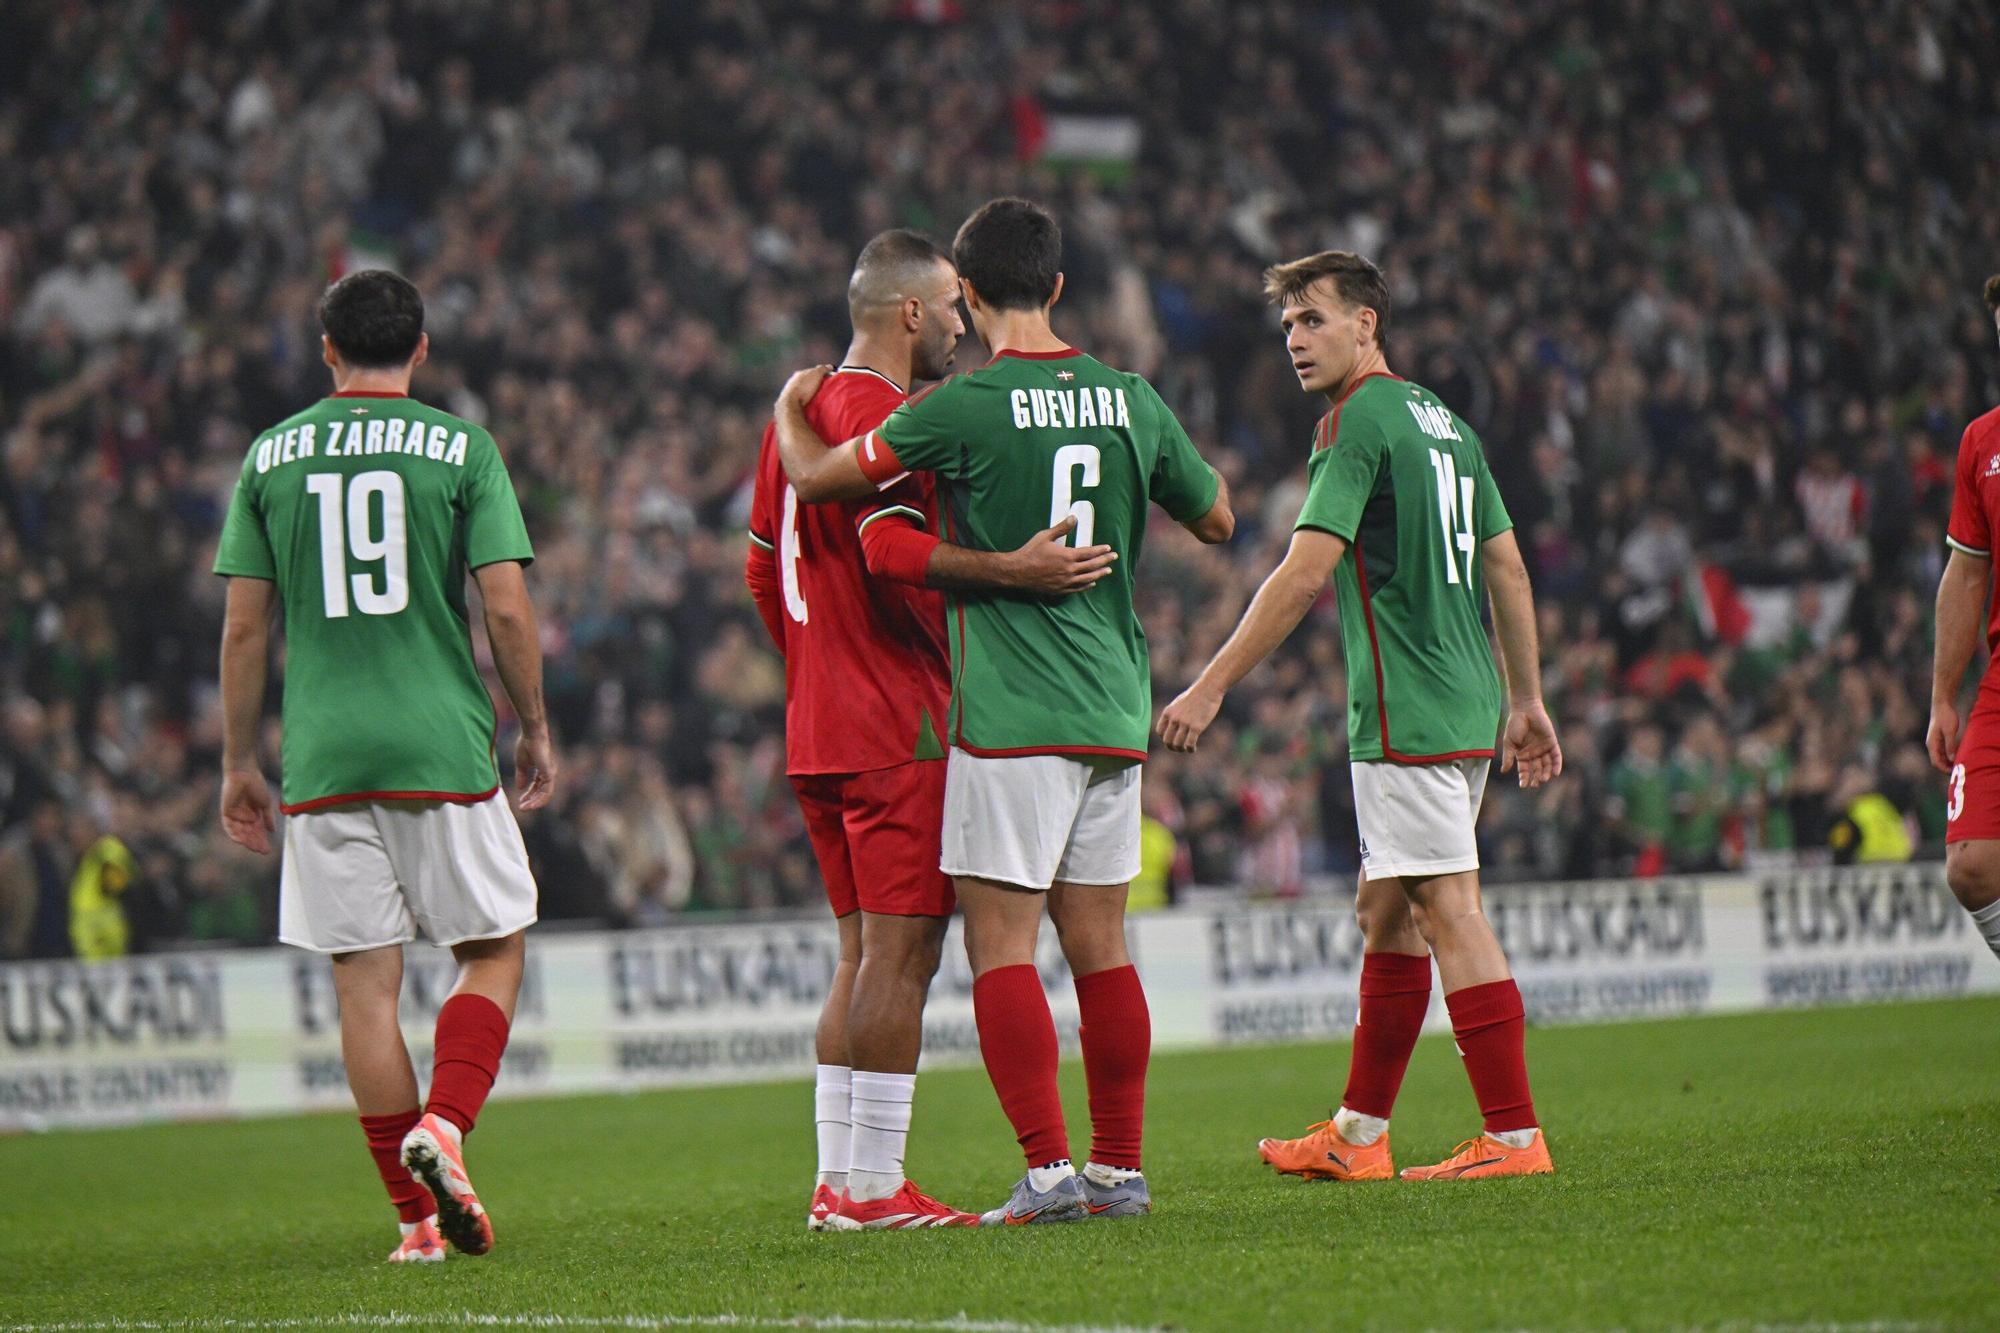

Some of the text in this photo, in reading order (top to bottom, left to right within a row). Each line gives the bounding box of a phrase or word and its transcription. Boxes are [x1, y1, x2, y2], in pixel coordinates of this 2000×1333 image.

[255, 418, 469, 474] OIER ZARRAGA
[1010, 386, 1130, 429] GUEVARA
[1049, 443, 1101, 549] 6
[1428, 447, 1475, 590] 14
[306, 470, 410, 618] 19
[611, 934, 838, 1015] EUSKAD
[1212, 905, 1363, 984] EUSK
